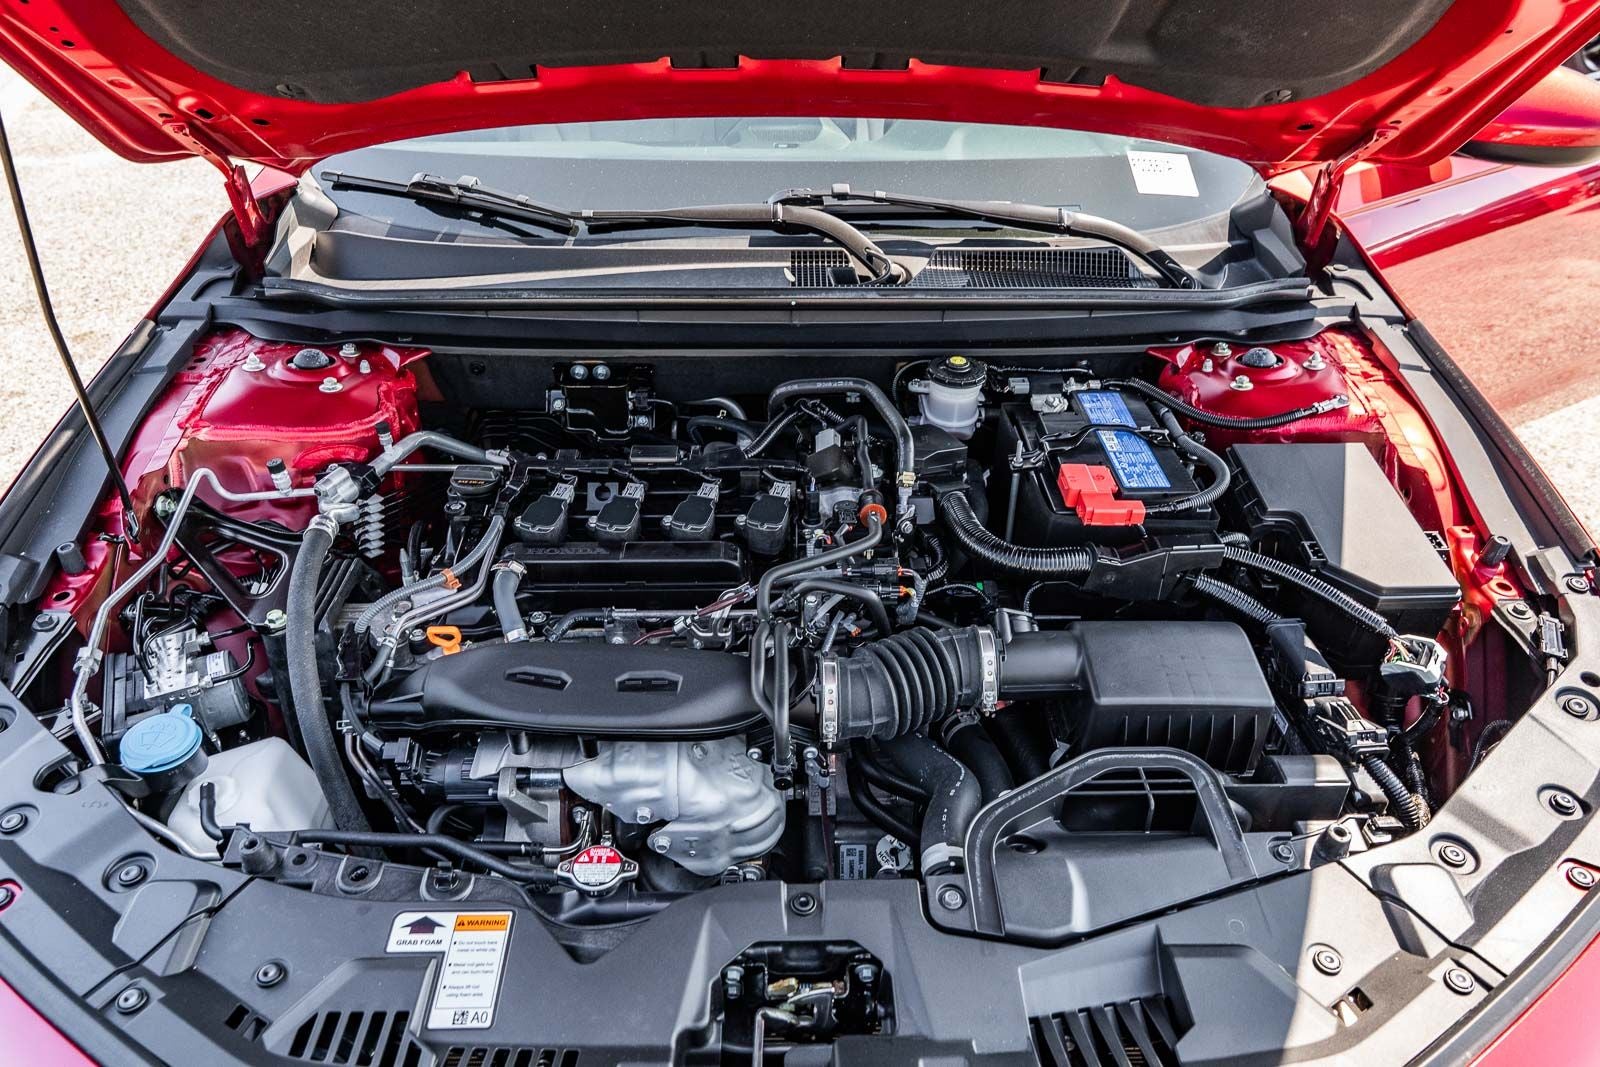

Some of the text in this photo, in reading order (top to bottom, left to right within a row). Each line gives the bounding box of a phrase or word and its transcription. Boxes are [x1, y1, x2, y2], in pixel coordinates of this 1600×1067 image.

[526, 547, 610, 555] HONDA
[467, 919, 506, 927] WARNING
[470, 1010, 489, 1024] A0
